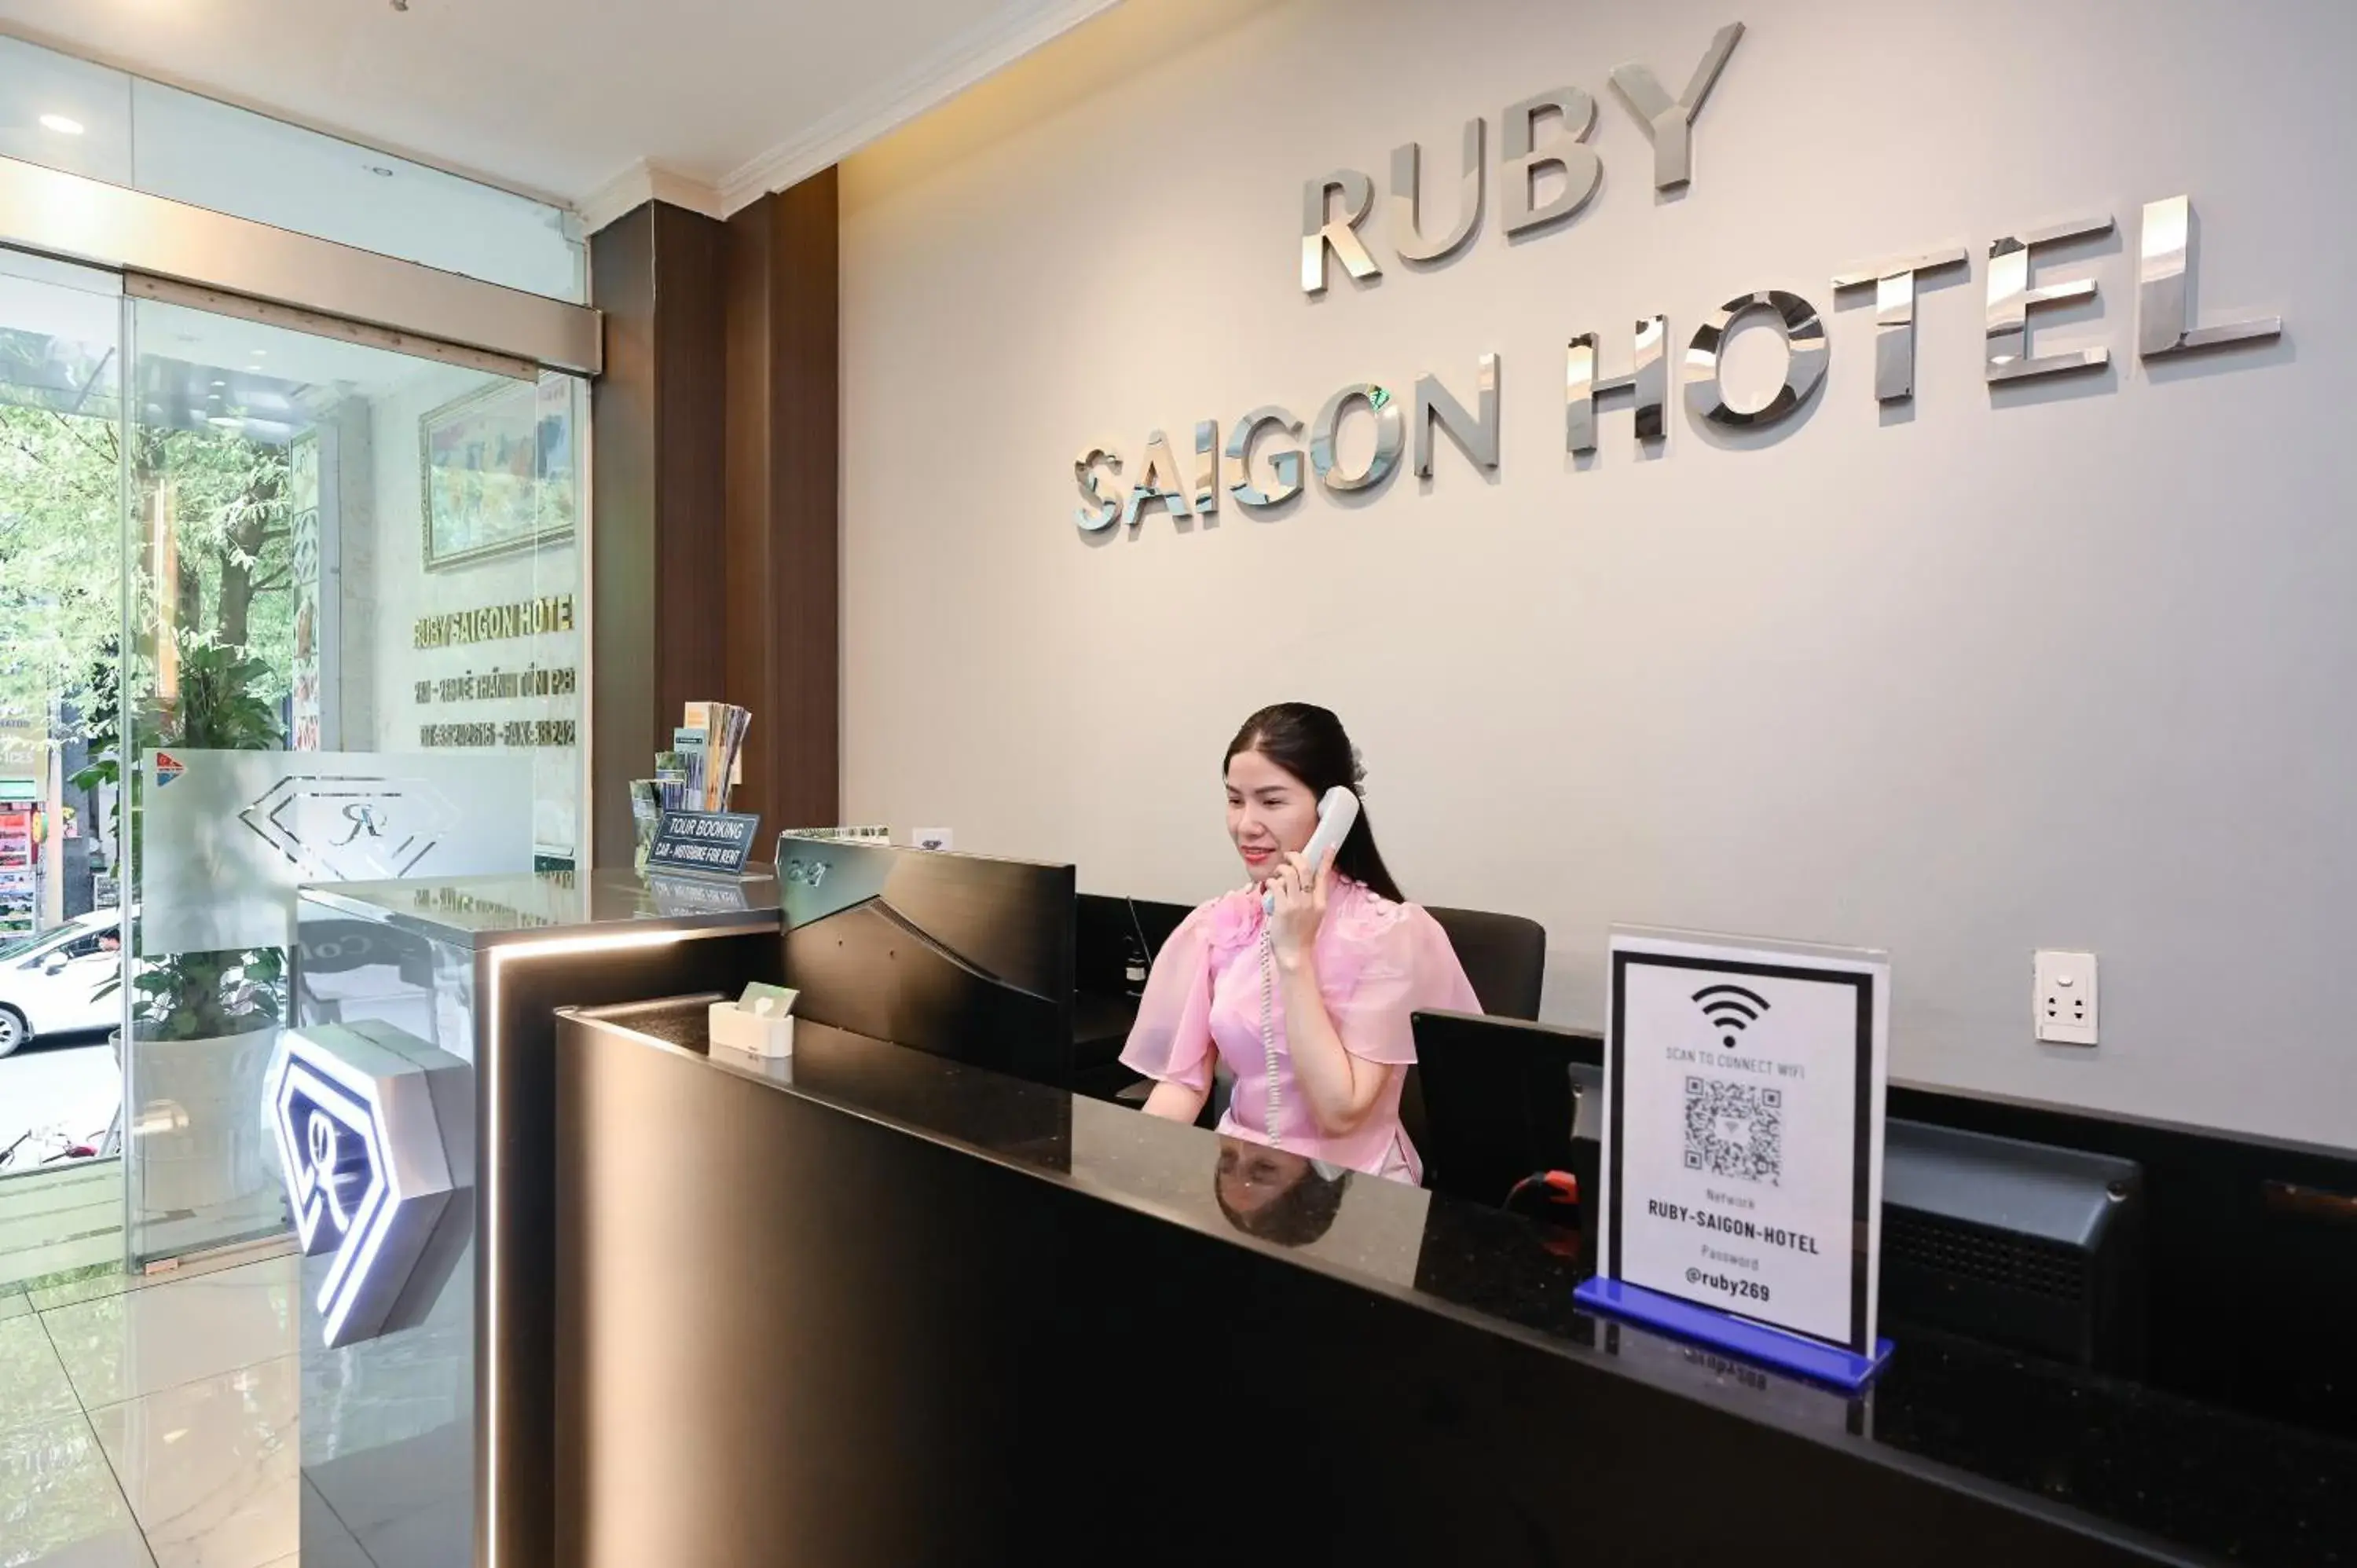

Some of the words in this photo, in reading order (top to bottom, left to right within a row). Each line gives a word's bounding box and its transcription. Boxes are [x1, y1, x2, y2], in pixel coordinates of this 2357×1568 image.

[1300, 22, 1745, 293] RUBY
[1074, 353, 1500, 532] SAIGON
[1567, 194, 2282, 453] HOTEL
[453, 604, 518, 643] SAIGON
[669, 818, 697, 835] TOUR
[696, 820, 744, 840] BOOKING
[654, 843, 671, 857] CAR
[706, 848, 722, 863] FOR
[720, 849, 740, 865] RENT
[1666, 1046, 1695, 1063] SCAN
[1699, 1051, 1714, 1067] TO
[1717, 1053, 1772, 1075] CONNECT
[1776, 1063, 1805, 1080] WIFI
[1706, 1188, 1755, 1210] Network
[1648, 1198, 1820, 1255] RUBY-SAIGON-HOTEL
[1700, 1244, 1759, 1271] Password
[1685, 1266, 1771, 1302] @ruby269
